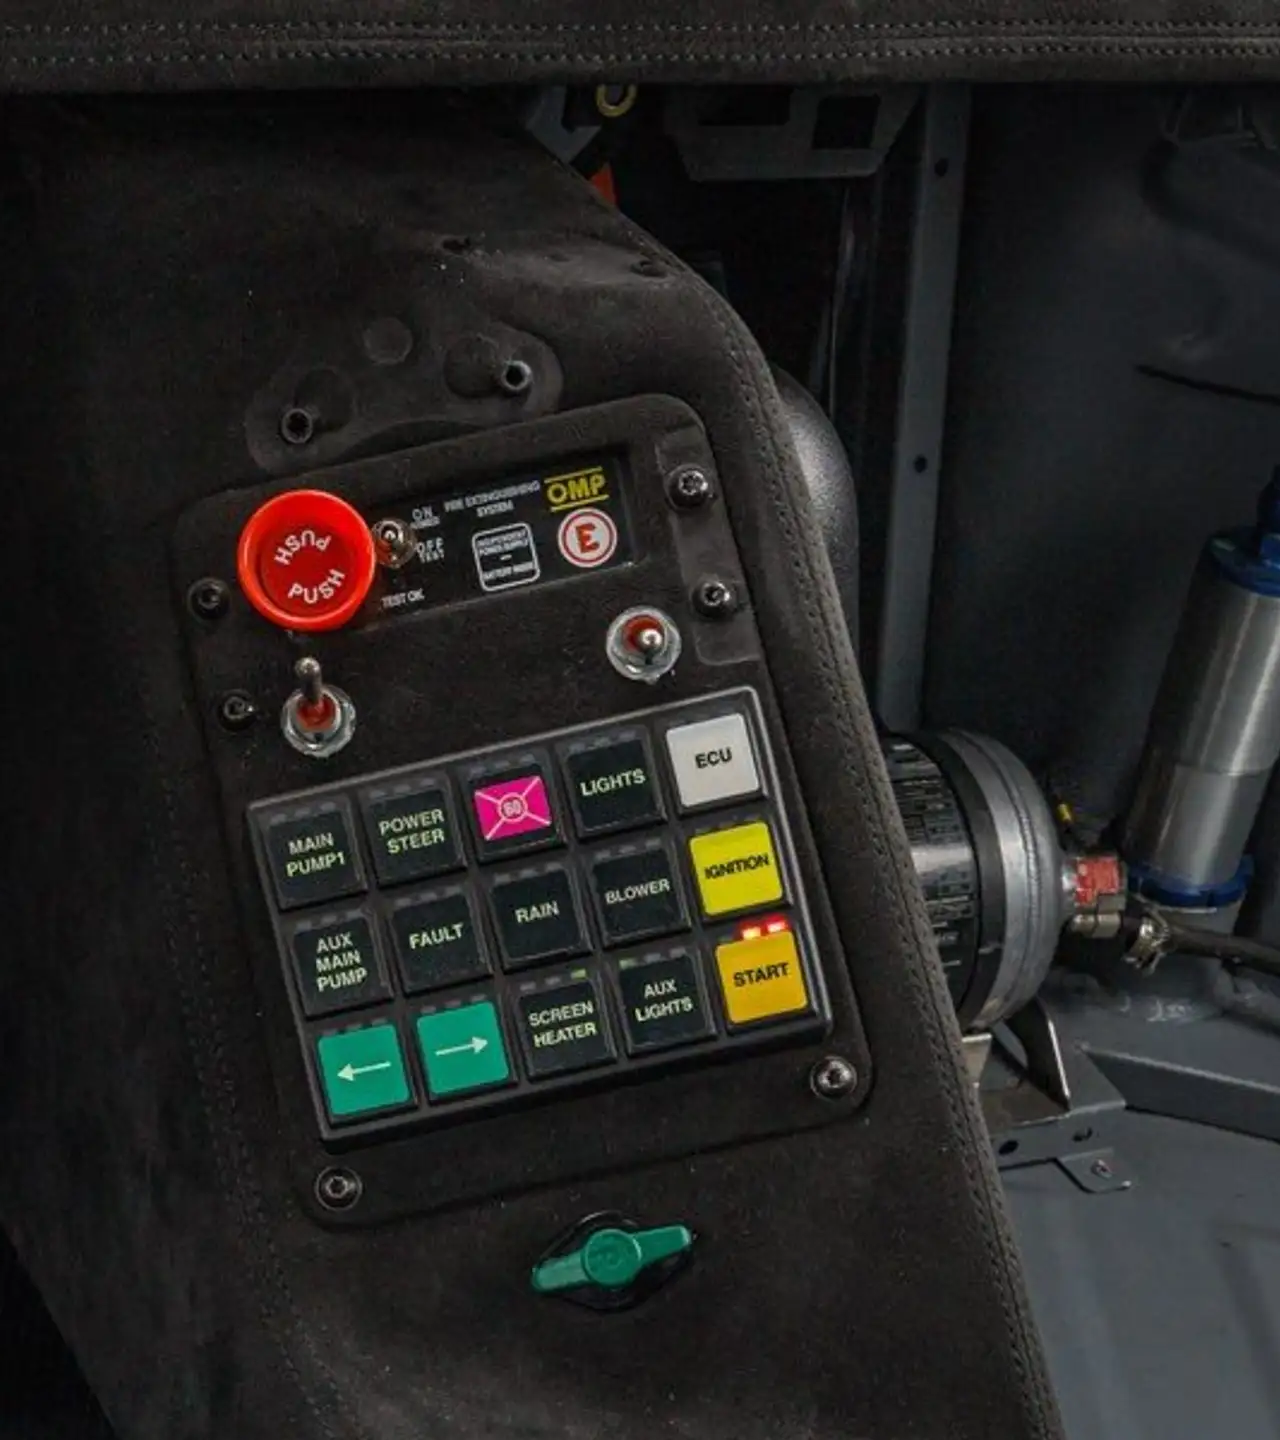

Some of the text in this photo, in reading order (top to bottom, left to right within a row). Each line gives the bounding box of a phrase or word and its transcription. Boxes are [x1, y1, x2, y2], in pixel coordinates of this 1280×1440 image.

[547, 474, 606, 504] OMP
[274, 529, 332, 566] PUSH
[575, 522, 601, 554] E
[287, 568, 345, 604] PUSH
[694, 747, 733, 769] ECU
[579, 768, 647, 797] LIGHTS
[379, 808, 445, 836] POWER
[288, 832, 334, 855] MAIN
[386, 828, 445, 855] STEER
[286, 851, 346, 877] PUMP1
[704, 853, 771, 879] IGNITION
[604, 878, 671, 904] BLOWER
[515, 901, 560, 924] RAIN
[317, 931, 354, 954] AUX
[408, 922, 464, 949] FAULT
[316, 949, 362, 972] MAIN
[316, 967, 368, 993] PUMP
[733, 961, 790, 987] START
[643, 978, 678, 1000] AUX
[528, 1000, 595, 1027] SCREEN
[634, 995, 694, 1022] LIGHTS
[533, 1021, 599, 1048] HEATER
